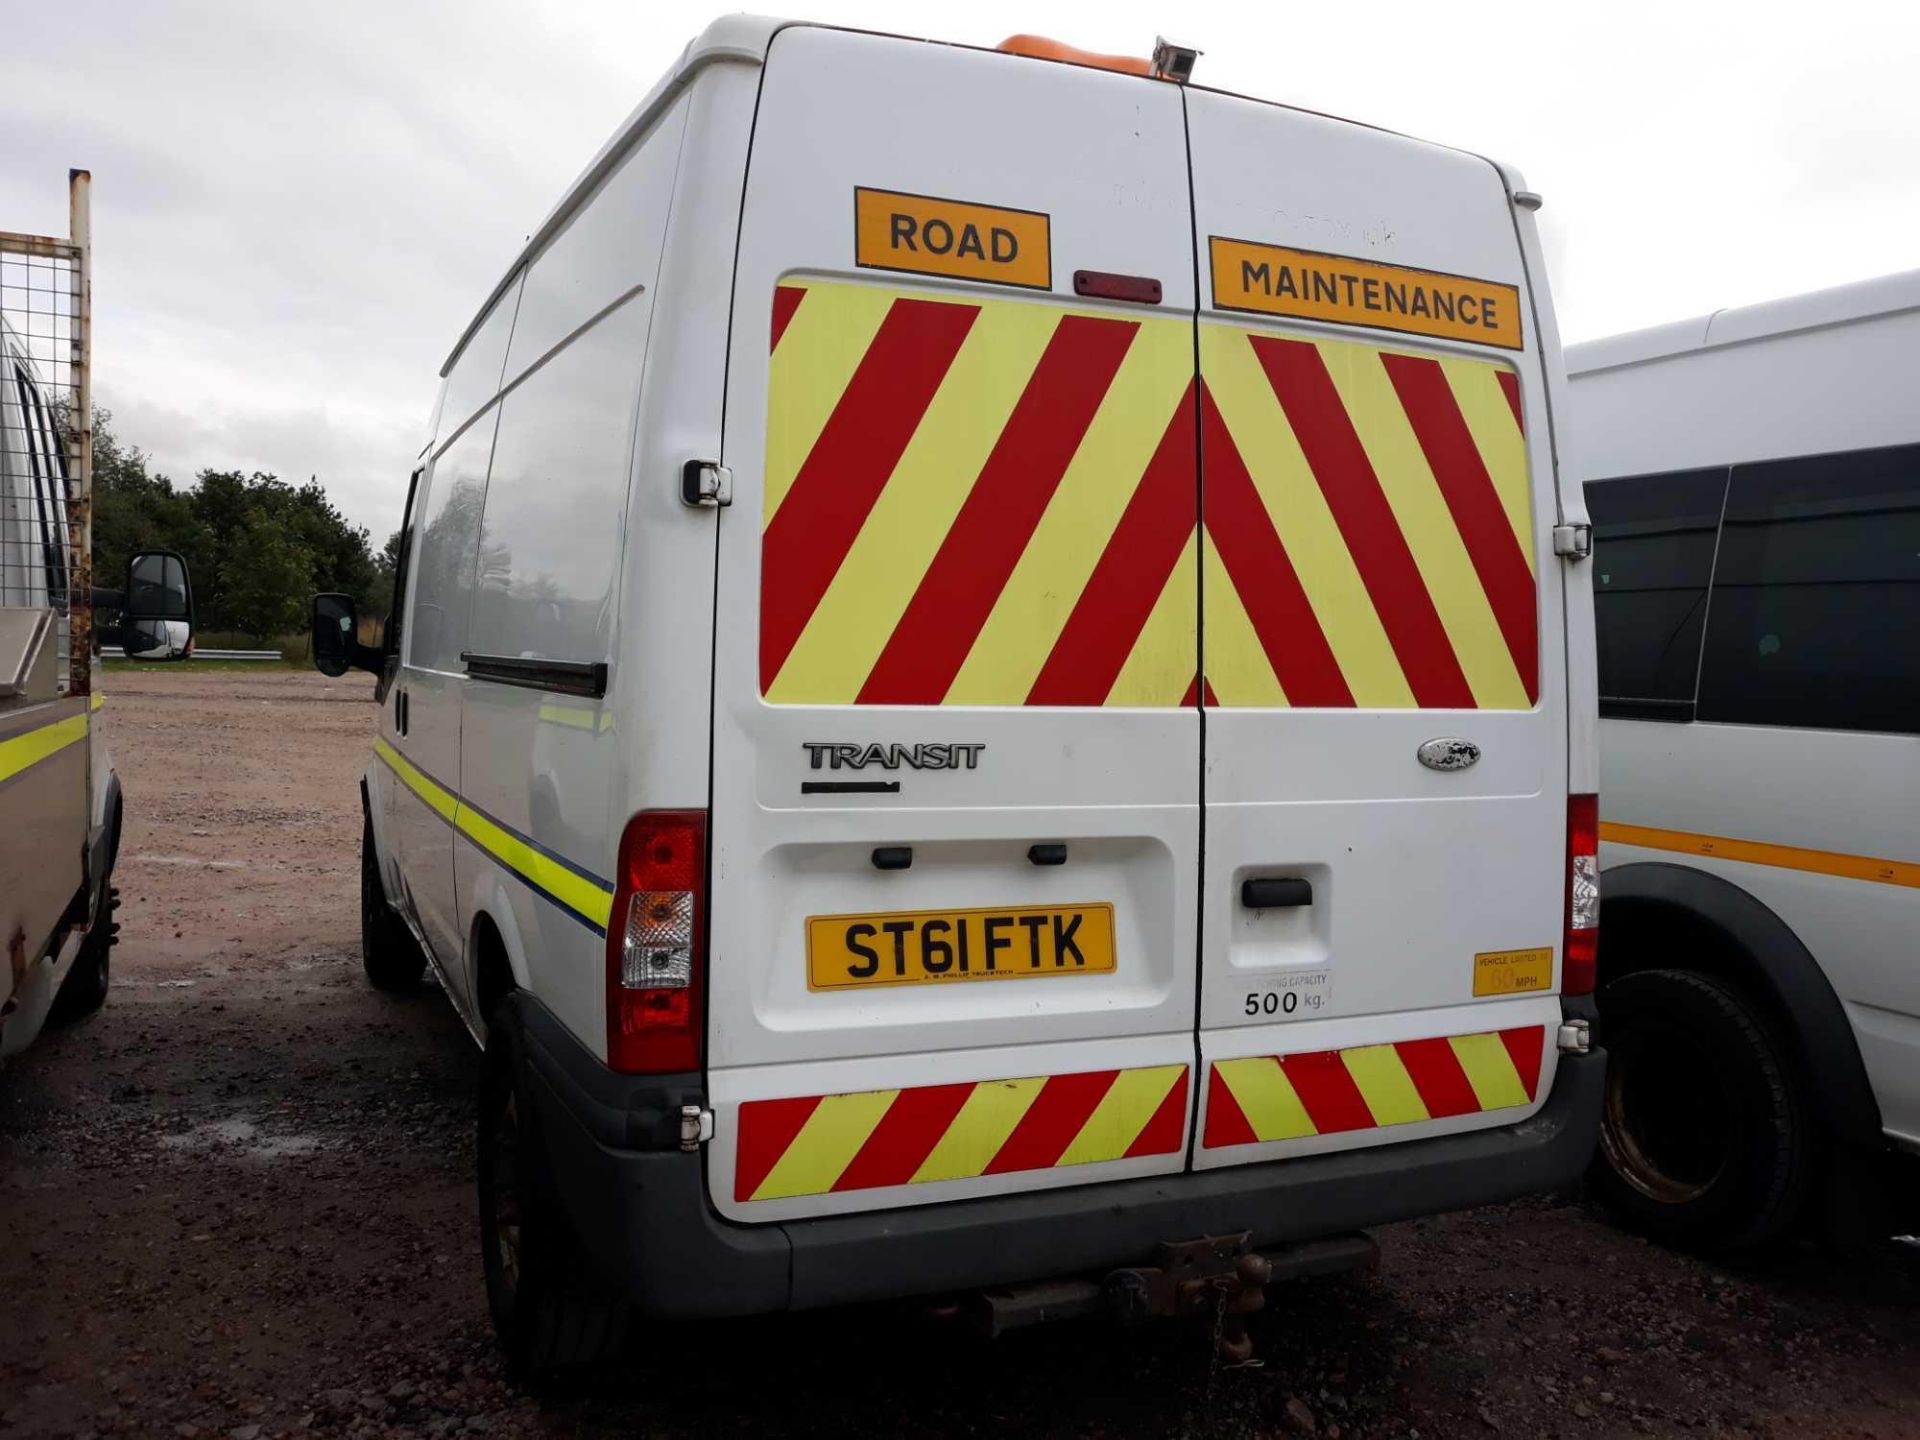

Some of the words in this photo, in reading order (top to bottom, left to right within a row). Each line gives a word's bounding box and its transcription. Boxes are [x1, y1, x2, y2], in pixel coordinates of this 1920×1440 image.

[891, 213, 1018, 263] ROAD
[1241, 260, 1499, 329] MAINTENANCE
[802, 742, 986, 770] TRANSIT
[845, 918, 969, 978] ST61
[983, 914, 1085, 970] FTK
[1515, 976, 1537, 988] MPH
[1245, 992, 1297, 1015] 500
